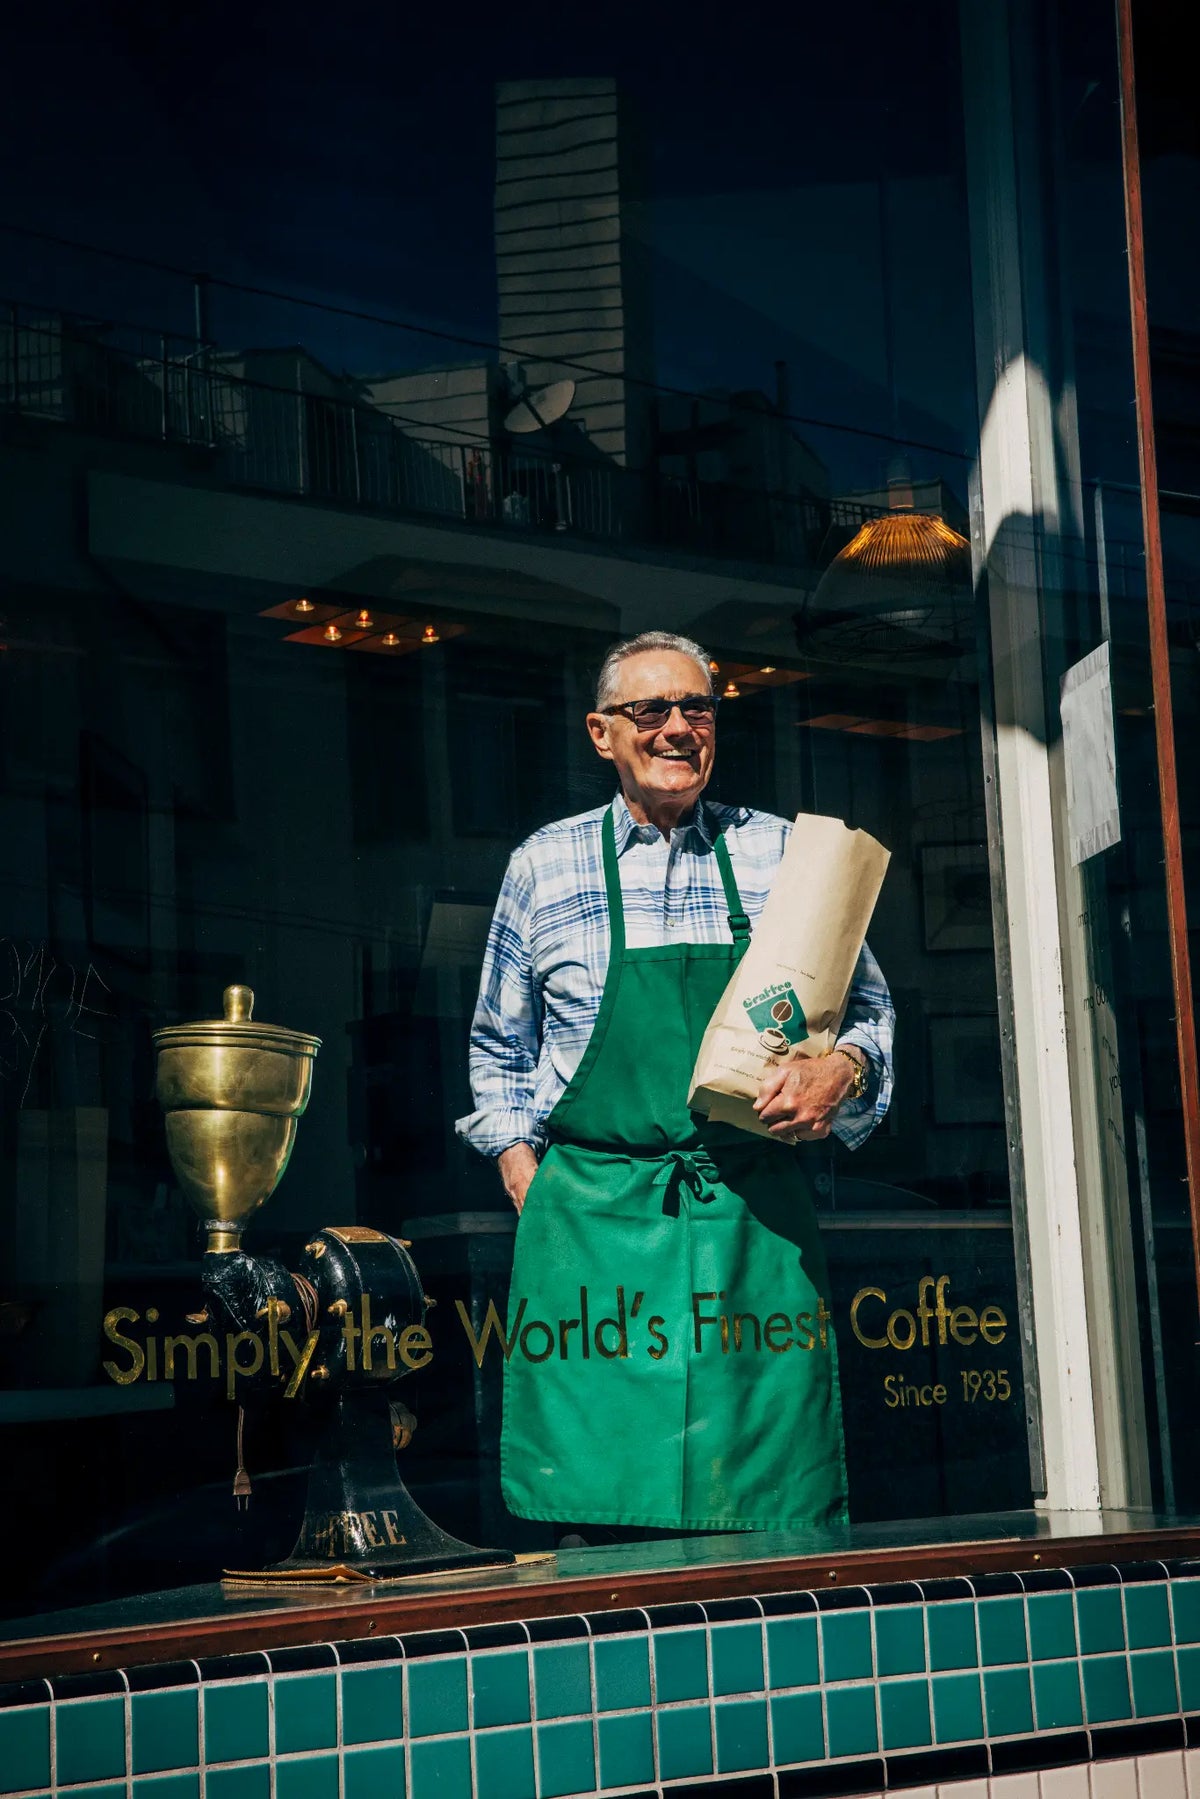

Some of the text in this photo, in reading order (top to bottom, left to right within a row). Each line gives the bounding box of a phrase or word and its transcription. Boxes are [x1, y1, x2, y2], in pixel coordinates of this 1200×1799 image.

[103, 1274, 1008, 1400] Simply the World's Finest Coffee
[883, 1370, 1012, 1408] Since 1935
